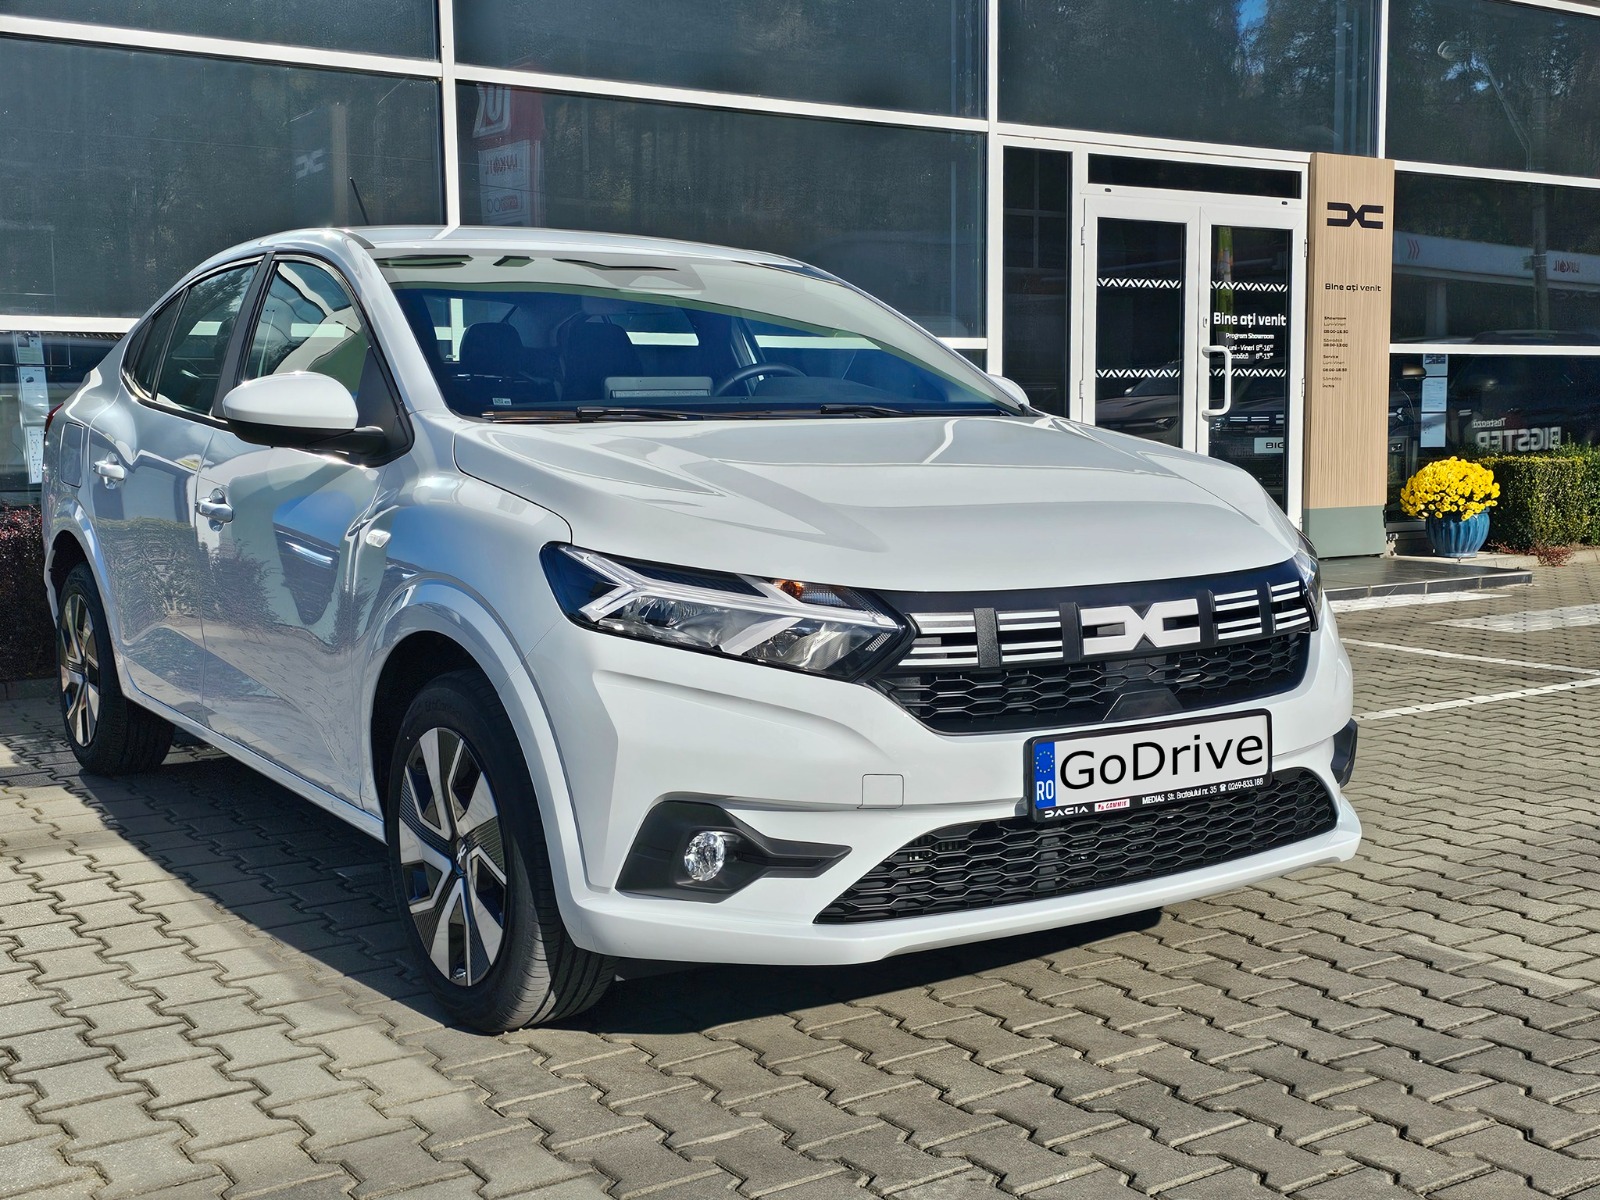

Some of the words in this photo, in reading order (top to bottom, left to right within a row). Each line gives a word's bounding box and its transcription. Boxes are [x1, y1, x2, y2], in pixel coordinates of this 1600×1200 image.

[1325, 282, 1344, 291] Bine
[1360, 284, 1382, 292] venit
[1213, 312, 1238, 325] Bine
[1258, 313, 1287, 326] venit
[1060, 734, 1263, 790] GoDrive
[1037, 780, 1055, 801] RO
[1142, 794, 1165, 805] MEDIAS
[1210, 785, 1218, 794] 35
[1044, 805, 1089, 818] DACIA
